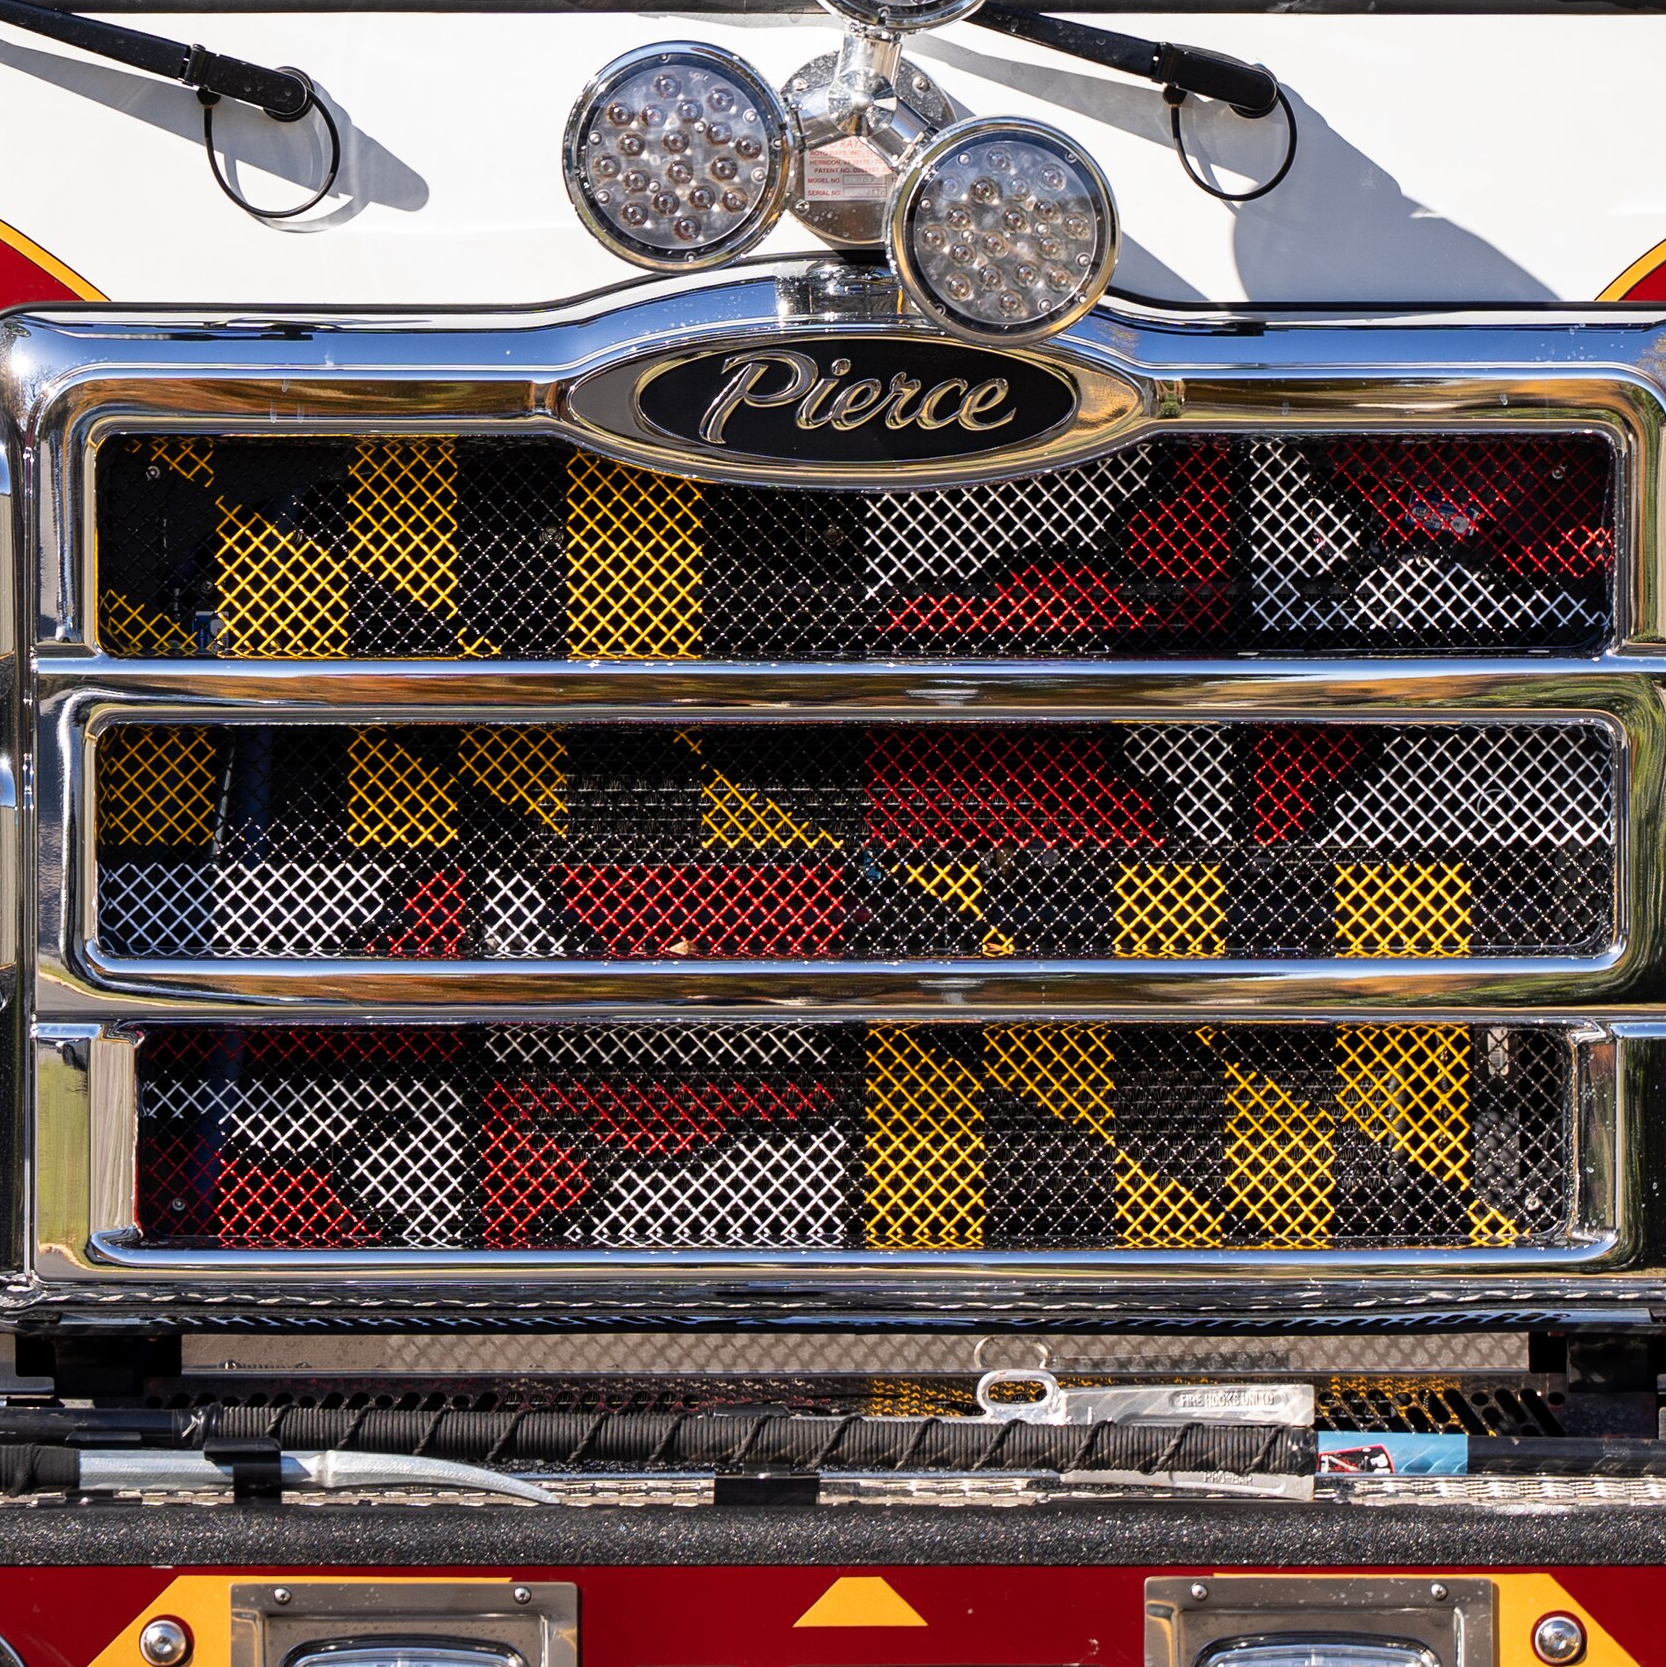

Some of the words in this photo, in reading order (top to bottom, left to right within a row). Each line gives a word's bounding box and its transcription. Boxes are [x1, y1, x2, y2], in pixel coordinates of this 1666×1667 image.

[698, 349, 1017, 445] Pierce
[1179, 1393, 1205, 1407] FIRE
[1205, 1391, 1240, 1407] HOOKS
